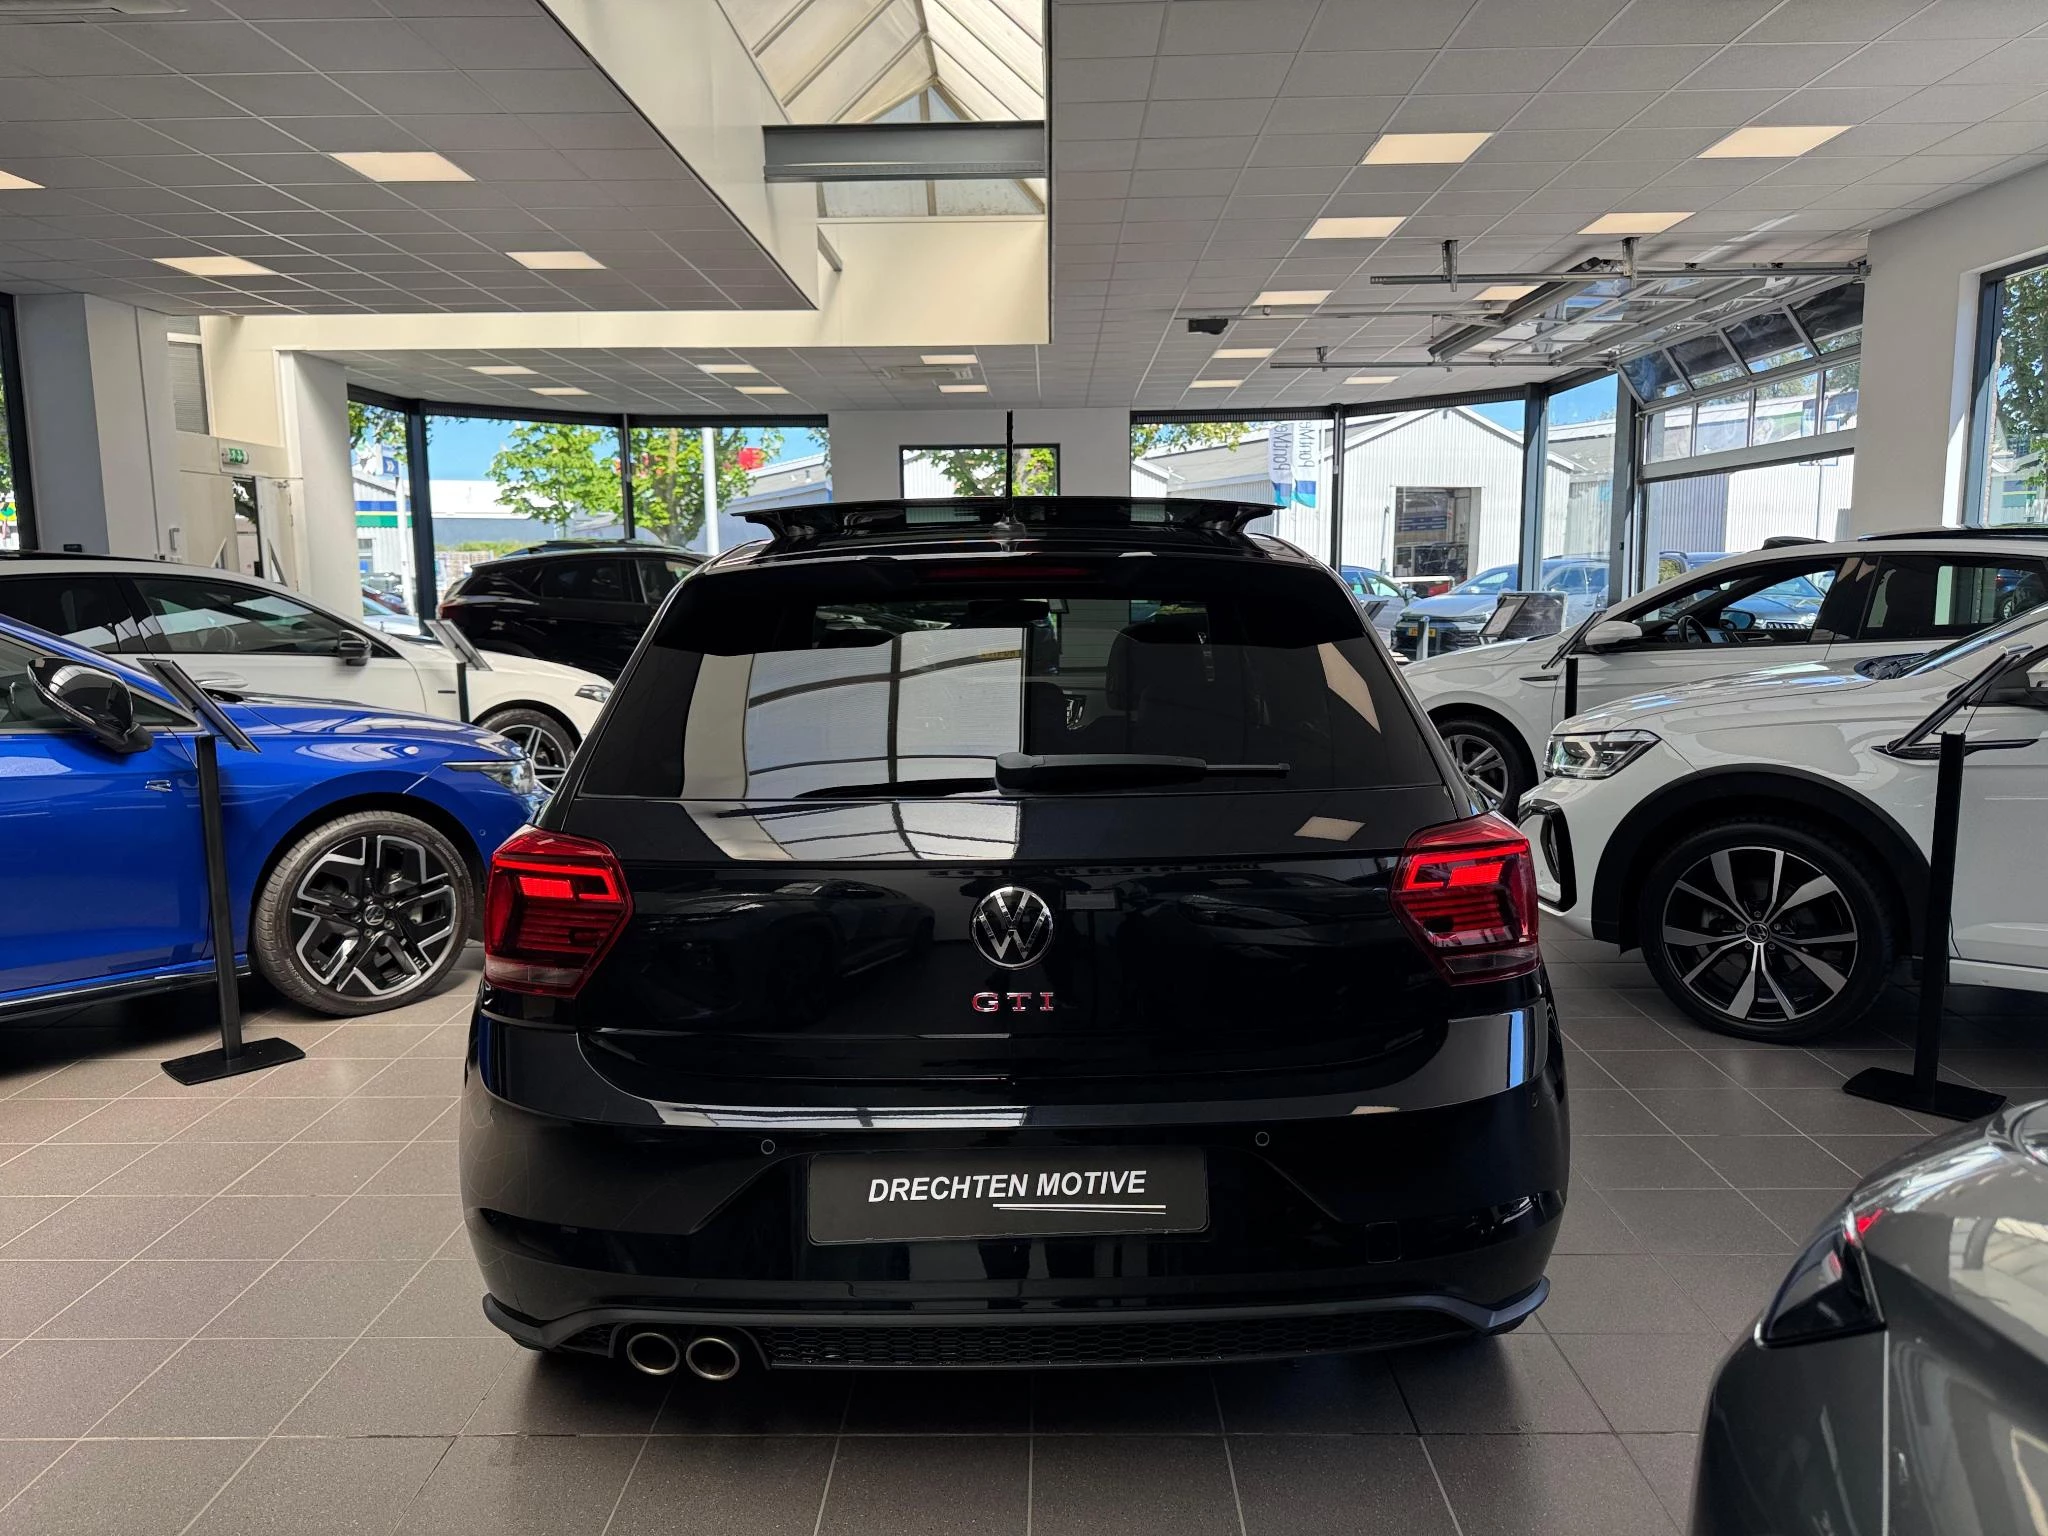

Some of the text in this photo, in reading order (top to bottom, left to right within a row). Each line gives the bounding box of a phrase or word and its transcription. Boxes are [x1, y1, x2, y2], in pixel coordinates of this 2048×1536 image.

[971, 991, 1055, 1013] GTI
[868, 1170, 1147, 1202] DRECHTEN MOTIVE
